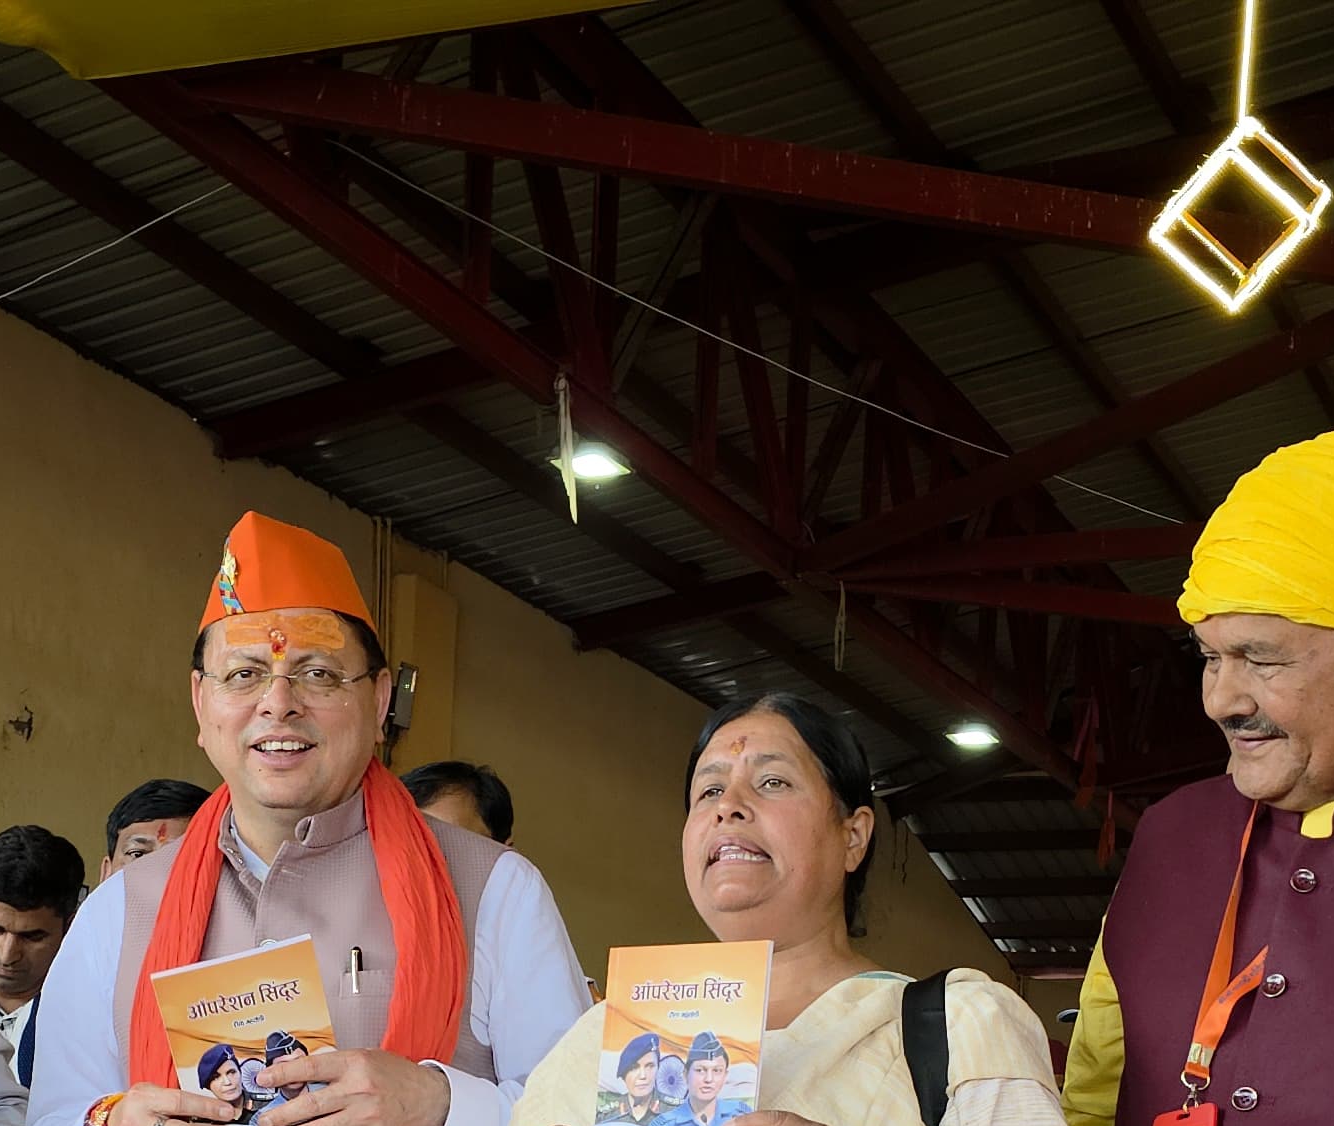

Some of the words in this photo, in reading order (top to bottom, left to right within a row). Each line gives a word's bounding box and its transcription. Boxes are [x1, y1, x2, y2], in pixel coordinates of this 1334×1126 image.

[188, 991, 256, 1020] ऑपरेशन
[259, 979, 301, 1003] सिंदूर
[703, 977, 744, 1003] सिंदूर
